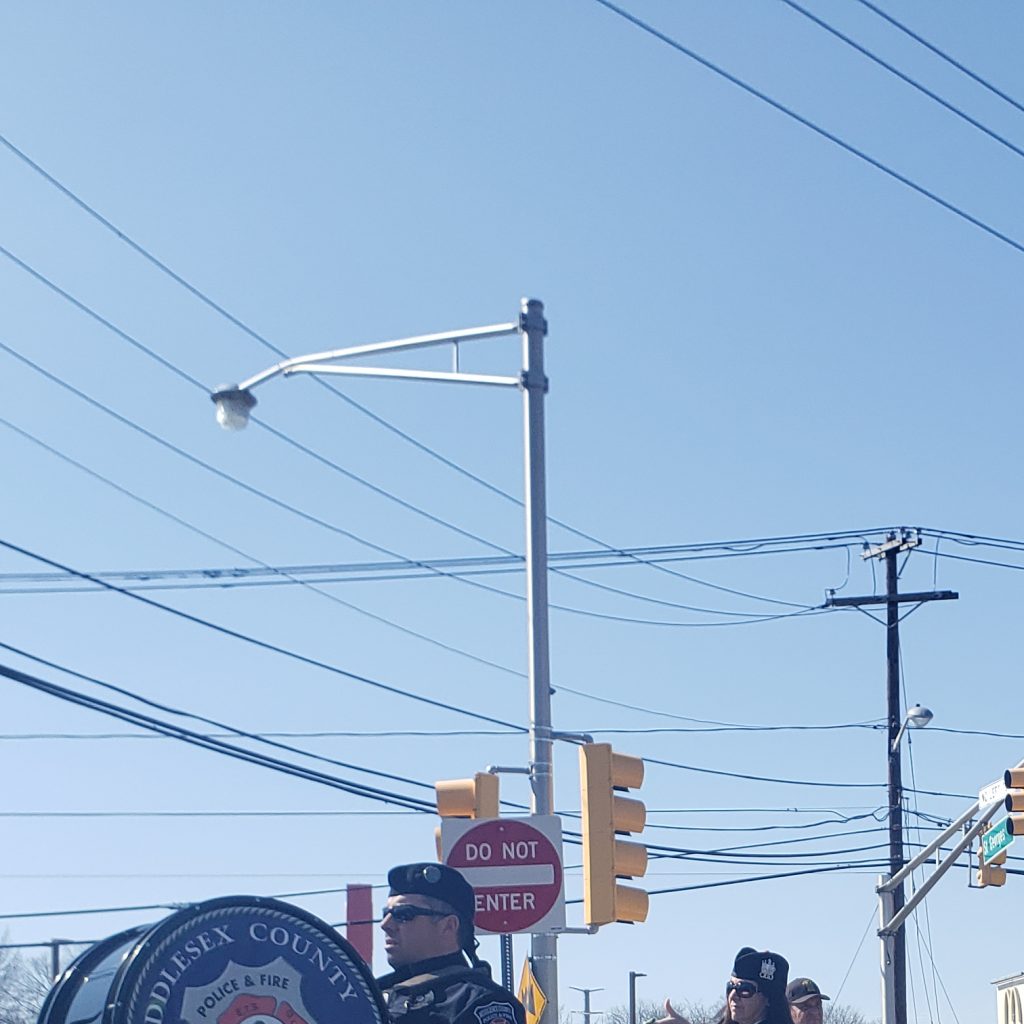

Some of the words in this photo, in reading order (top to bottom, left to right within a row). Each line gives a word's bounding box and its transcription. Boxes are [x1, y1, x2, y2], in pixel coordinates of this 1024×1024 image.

[465, 843, 492, 860] DO
[502, 841, 538, 860] NOT
[474, 892, 535, 911] ENTER
[249, 922, 358, 1002] COUNTY
[196, 976, 241, 1018] POLICE
[244, 974, 256, 988] &
[259, 973, 290, 990] FIRE
